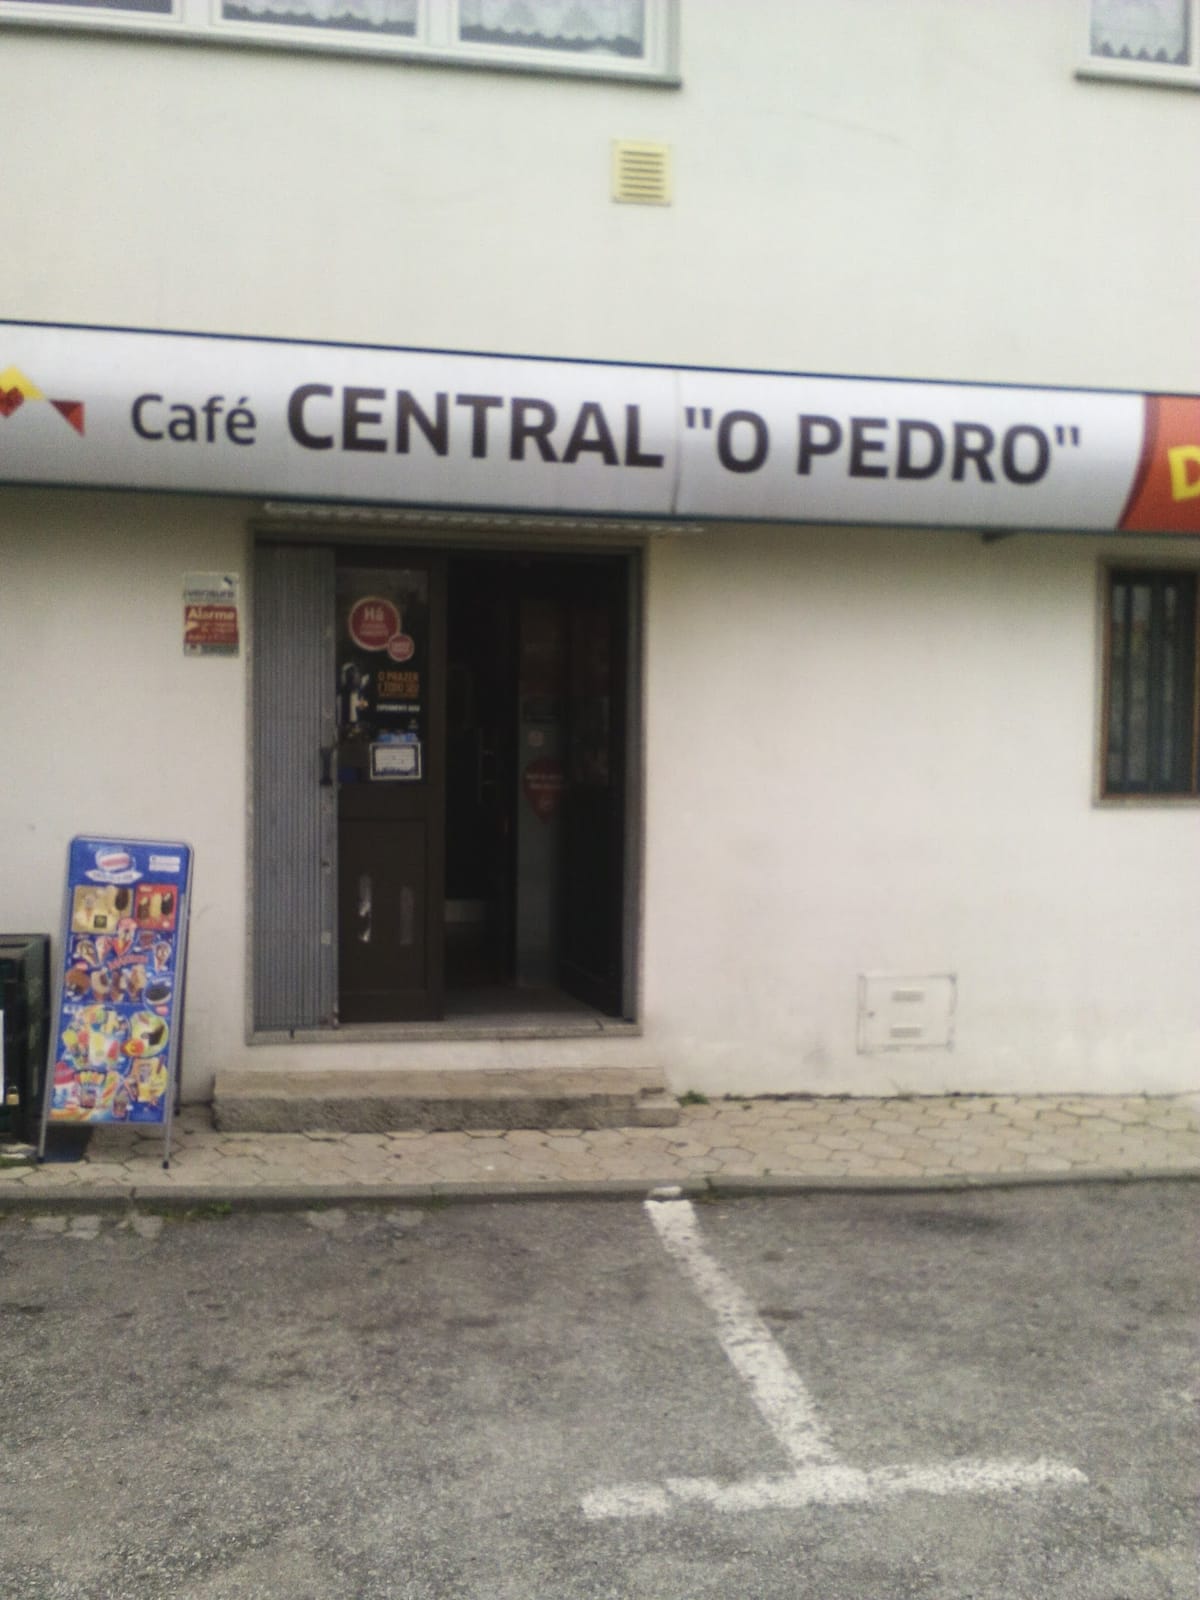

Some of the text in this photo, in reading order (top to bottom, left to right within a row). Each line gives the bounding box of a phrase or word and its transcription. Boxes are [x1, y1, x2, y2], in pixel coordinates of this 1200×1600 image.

[131, 383, 1081, 487] Café CENTRAL "O PEDRO"
